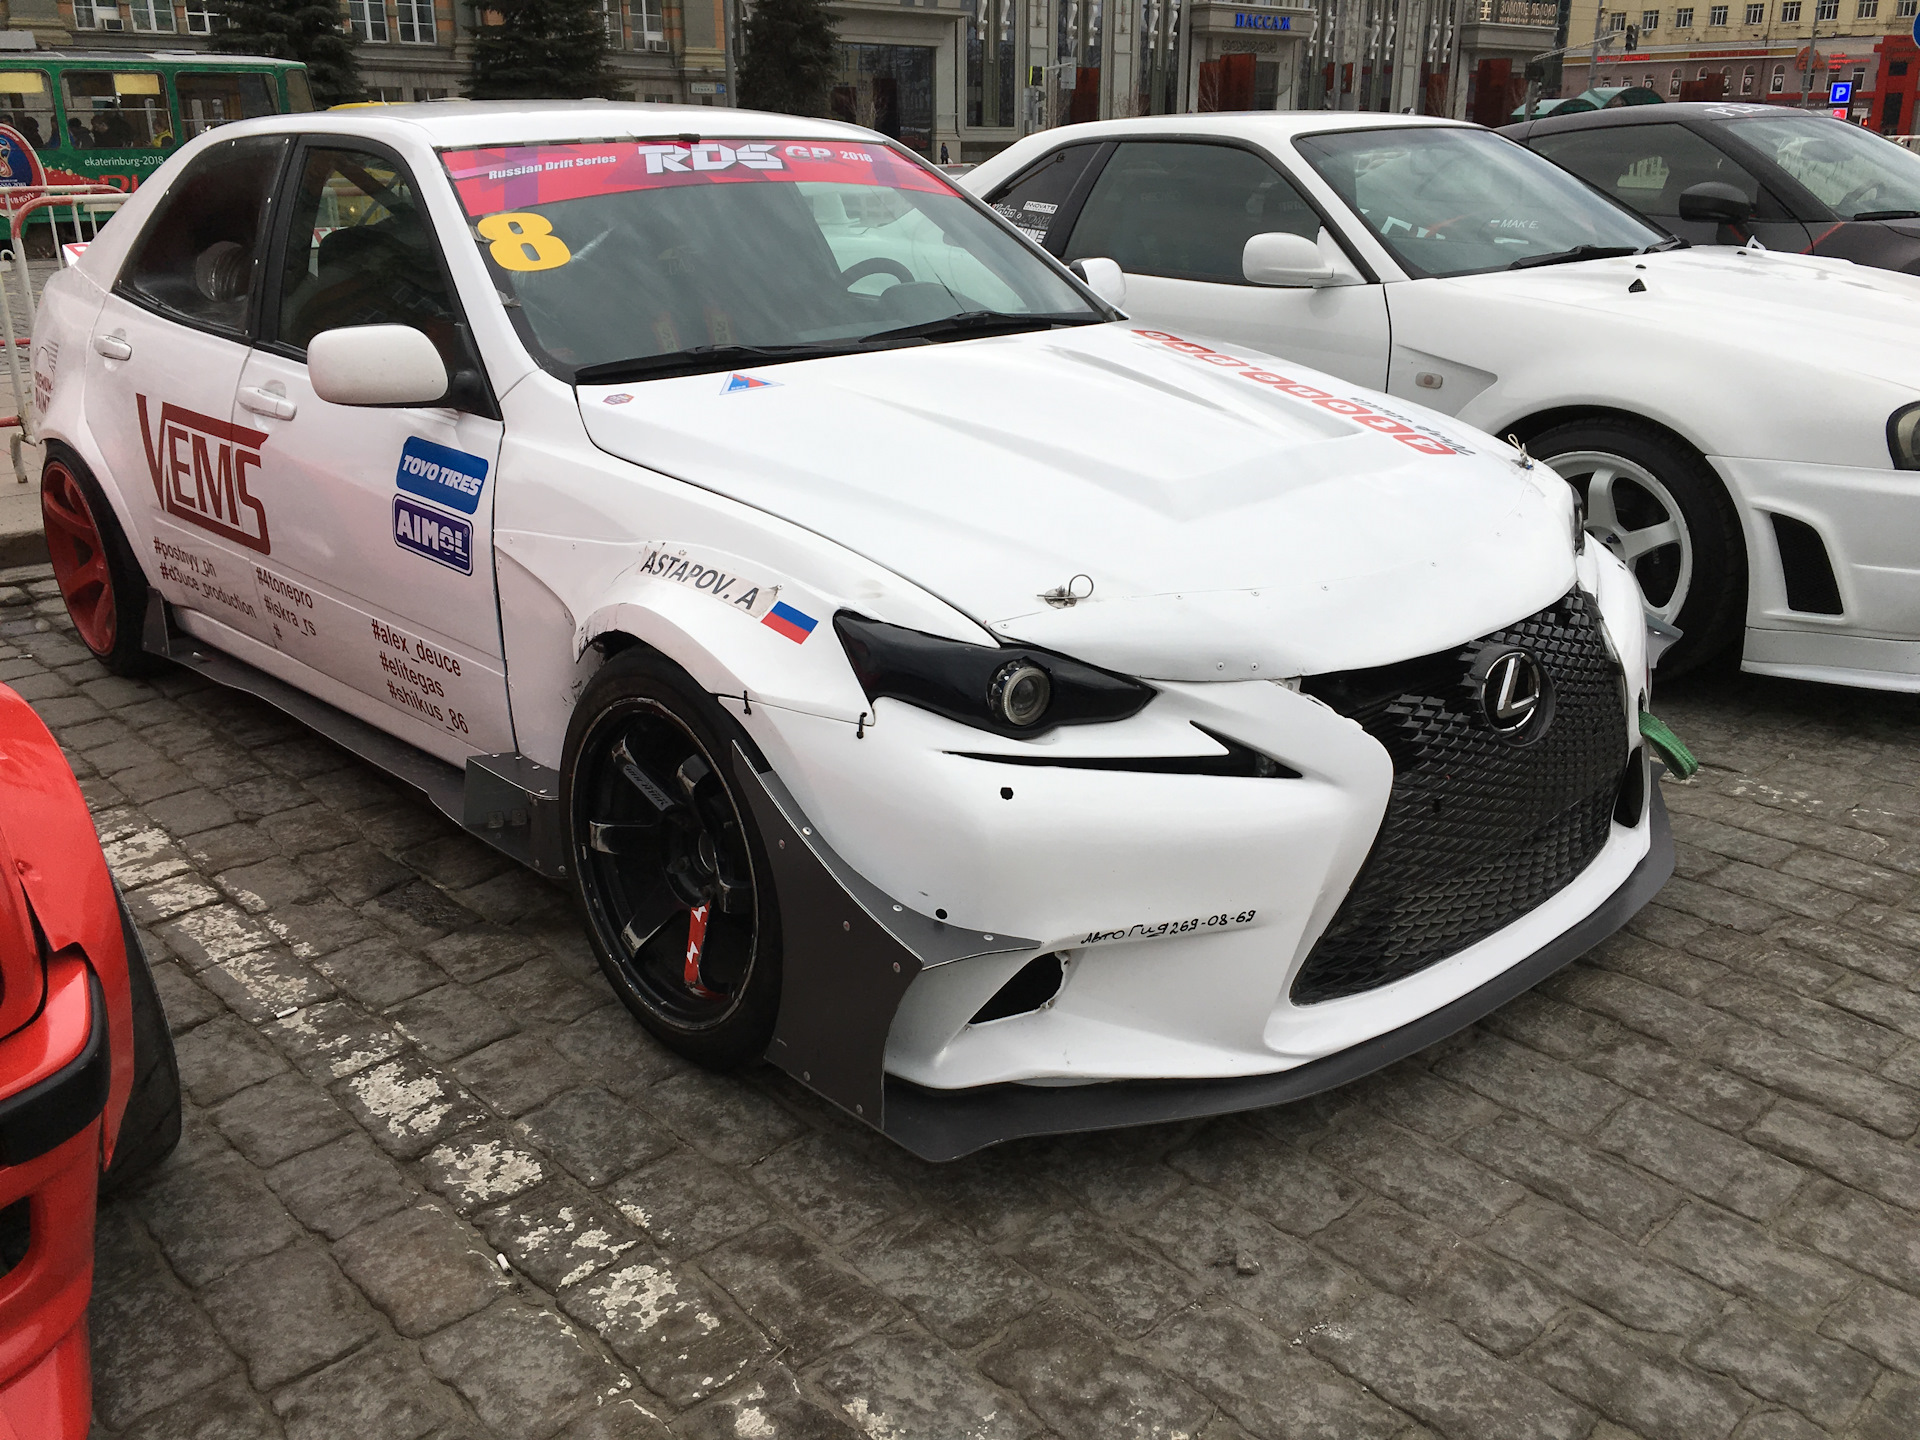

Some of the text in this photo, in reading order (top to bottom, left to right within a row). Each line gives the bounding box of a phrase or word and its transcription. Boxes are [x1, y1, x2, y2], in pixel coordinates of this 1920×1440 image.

[1235, 13, 1291, 30] ПАССАЖ
[84, 155, 165, 168] ekaterinburg-2018
[488, 154, 617, 180] Russian Drift Series
[638, 143, 783, 174] RDS
[842, 150, 873, 163] 2018
[477, 212, 571, 272] 8
[136, 393, 271, 556] VEMS
[402, 454, 483, 496] TOYO TIRES
[153, 536, 217, 577] #postnyy_ph
[396, 508, 469, 563] AIMOL
[160, 562, 258, 619] #d3uce_production
[256, 567, 313, 609] #4tonepro
[734, 587, 760, 610] A
[263, 594, 317, 637] #iskra_rs
[371, 618, 462, 677] #alex_deuce
[379, 650, 445, 698] #elitegas
[386, 679, 469, 735] #shikus_86
